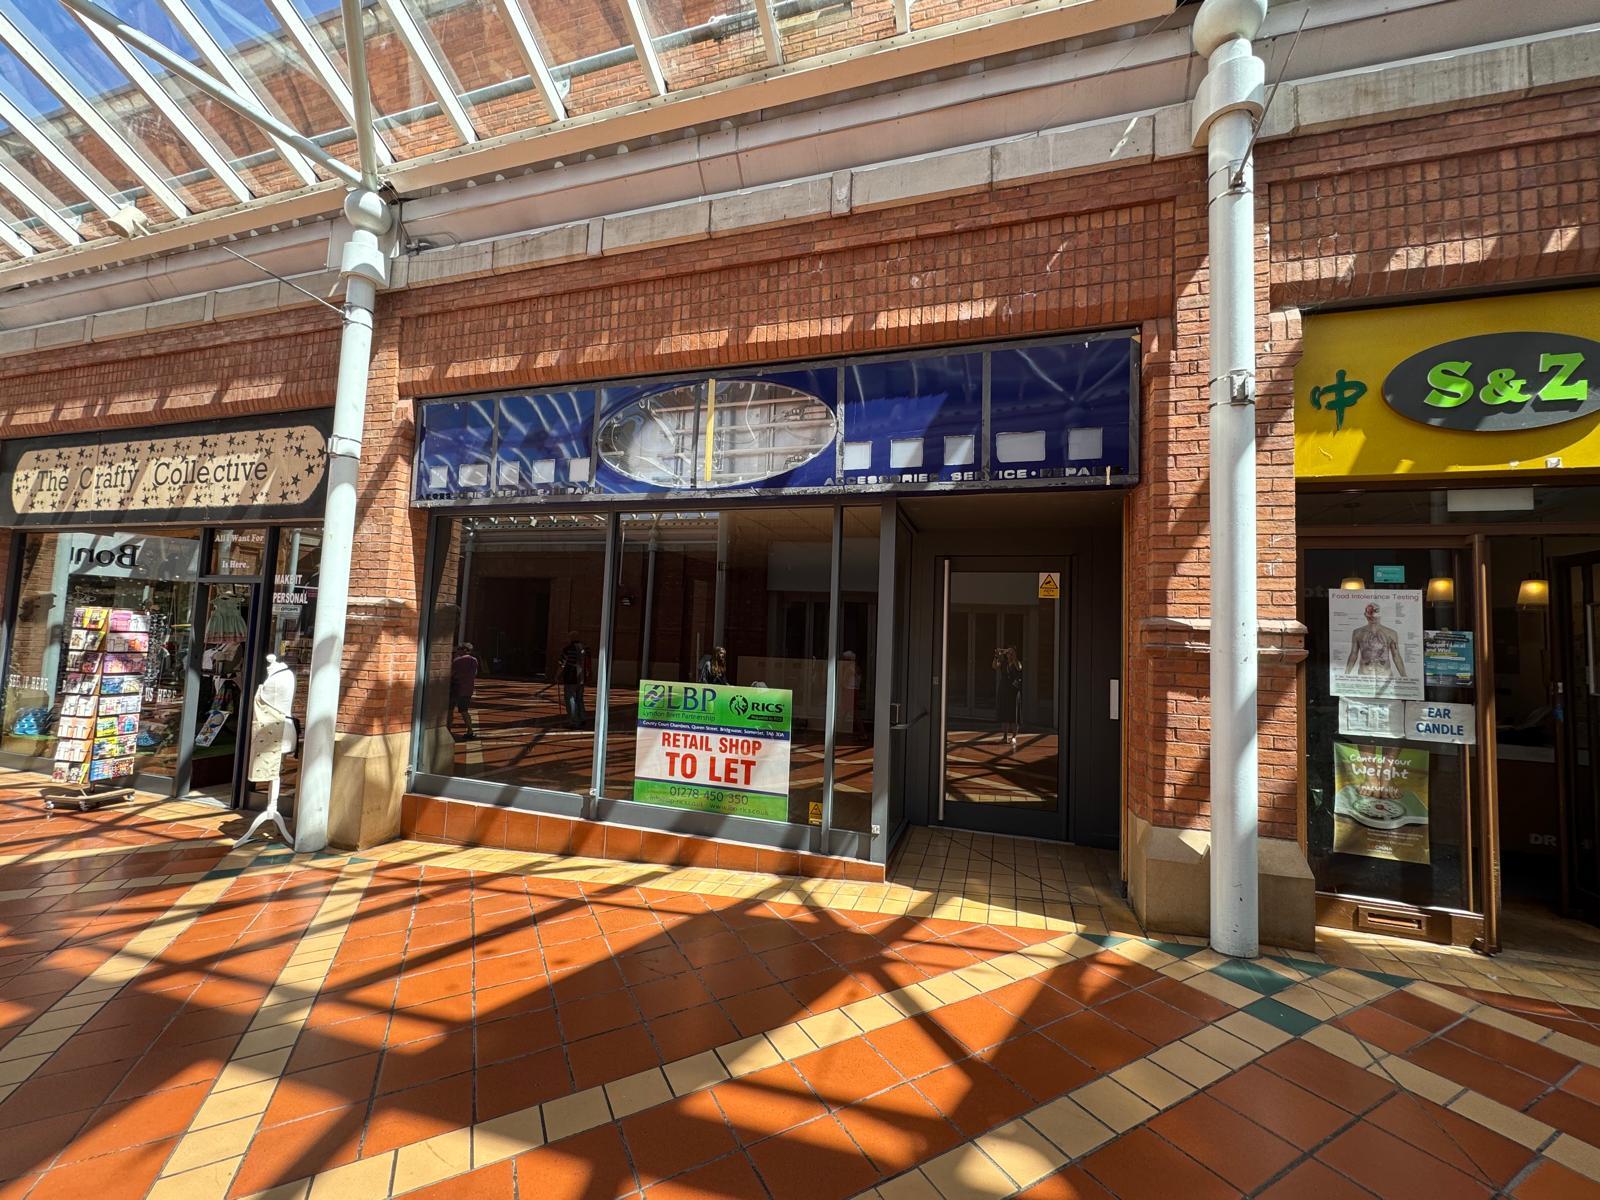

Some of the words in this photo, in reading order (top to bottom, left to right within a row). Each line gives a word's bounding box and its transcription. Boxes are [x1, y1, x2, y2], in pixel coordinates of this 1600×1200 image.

[36, 469, 69, 492] The
[79, 465, 139, 494] Crafty
[154, 455, 268, 486] Collective
[231, 534, 250, 542] Want
[250, 534, 264, 542] For
[221, 560, 228, 568] Is
[275, 575, 294, 584] MAKE
[294, 575, 302, 585] IT
[273, 593, 308, 604] PERSONAL
[1393, 594, 1419, 602] Testing
[667, 685, 717, 713] LBP
[752, 702, 783, 713] RICS
[1428, 707, 1451, 719] EAR
[682, 712, 716, 722] Partnership
[1416, 722, 1464, 736] CANDLE
[662, 731, 713, 752] RETAIL
[719, 737, 762, 756] SHOP
[1349, 754, 1385, 764] Control
[1387, 758, 1412, 766] your
[665, 751, 698, 779] TO
[709, 755, 757, 786] LET
[669, 786, 699, 799] 01278
[703, 790, 724, 802] 450
[727, 793, 749, 805] 350
